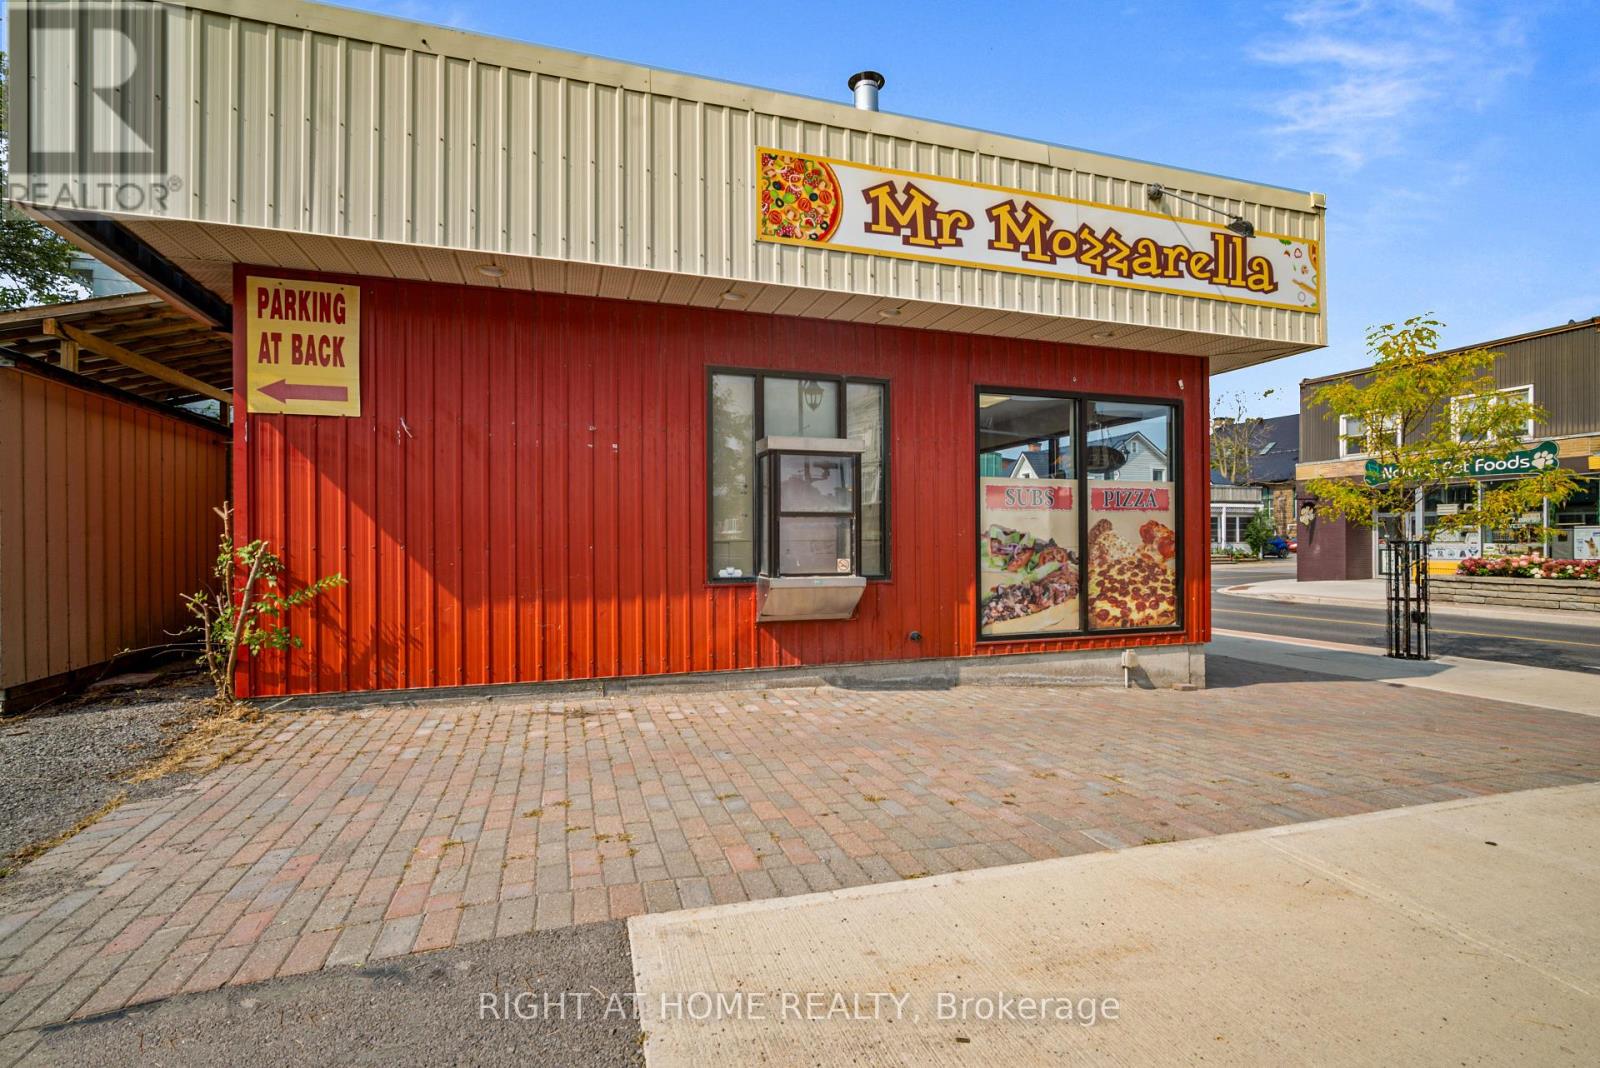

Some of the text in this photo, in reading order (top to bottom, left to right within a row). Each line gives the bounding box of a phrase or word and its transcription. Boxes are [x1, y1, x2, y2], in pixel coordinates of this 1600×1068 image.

[861, 180, 1278, 294] Mr Mozzarella
[257, 287, 346, 324] PARKING
[258, 331, 345, 367] AT BACK
[1475, 455, 1530, 472] Foods
[1004, 487, 1056, 507] SUBS
[1103, 489, 1159, 508] PIZZA
